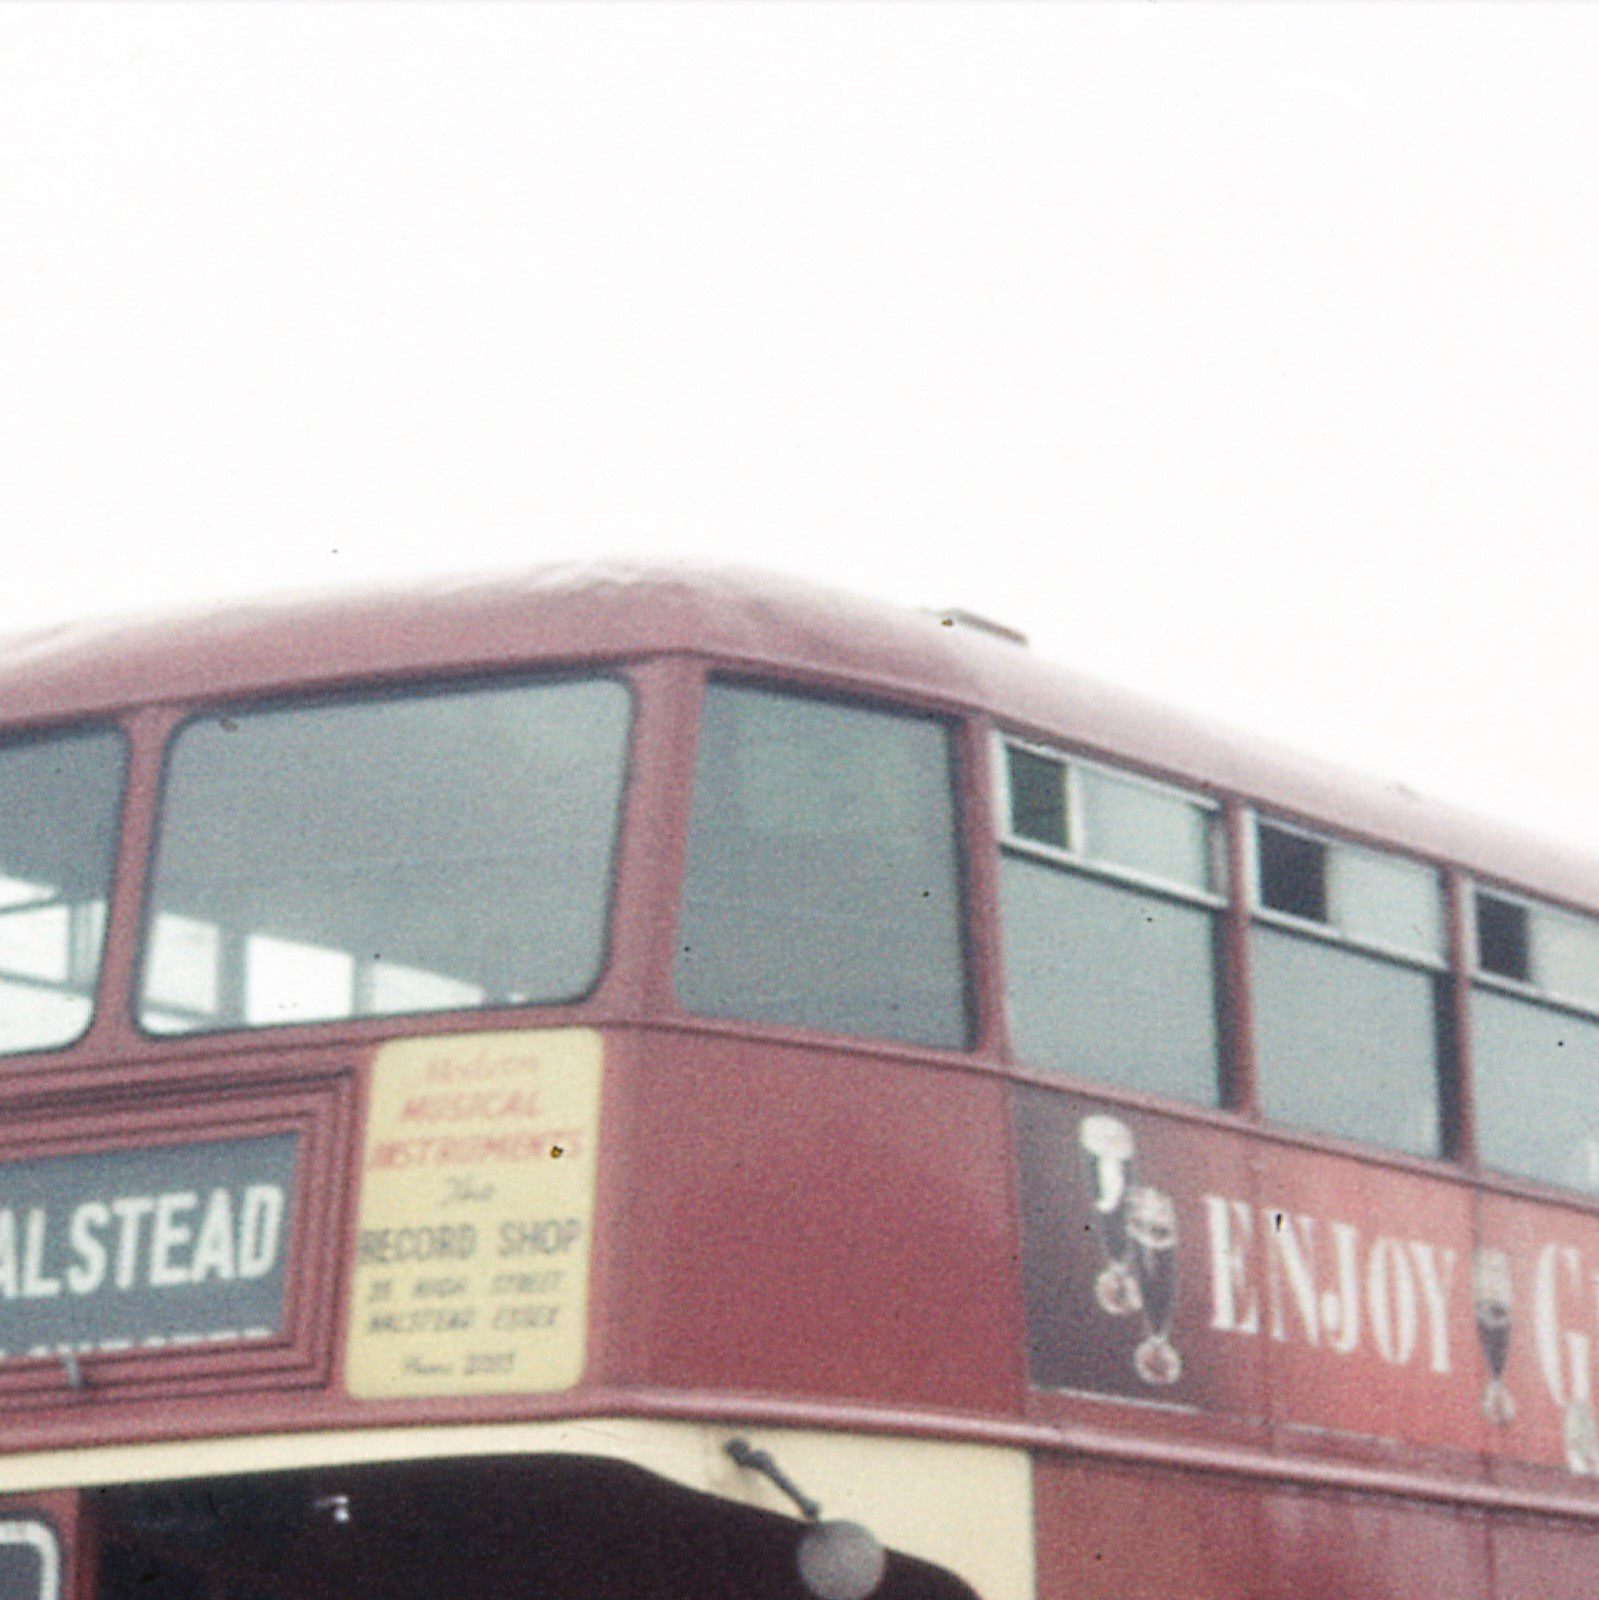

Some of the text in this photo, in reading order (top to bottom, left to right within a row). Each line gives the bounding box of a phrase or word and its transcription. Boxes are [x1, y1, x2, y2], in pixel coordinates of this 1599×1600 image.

[358, 1216, 583, 1266] RECORD SHOP
[1204, 1194, 1457, 1376] ENJOY
